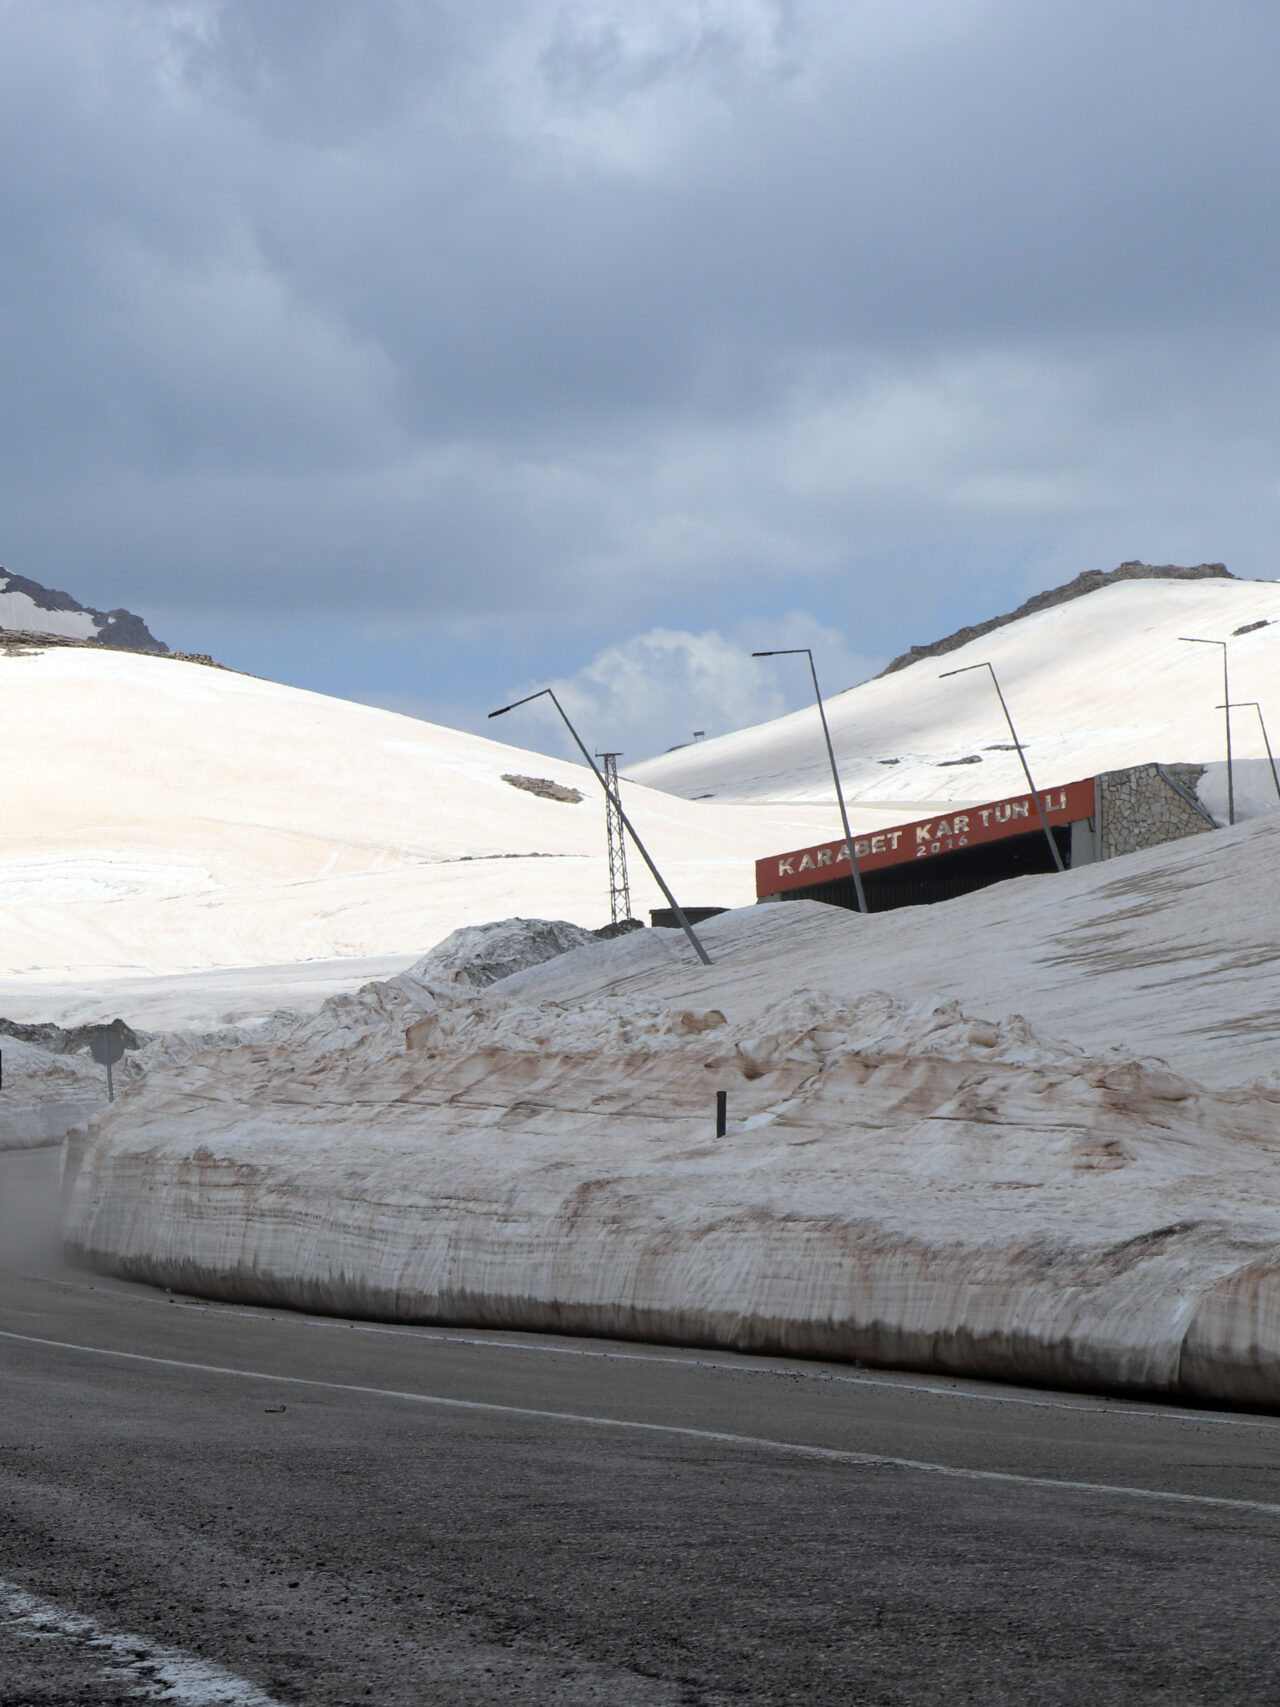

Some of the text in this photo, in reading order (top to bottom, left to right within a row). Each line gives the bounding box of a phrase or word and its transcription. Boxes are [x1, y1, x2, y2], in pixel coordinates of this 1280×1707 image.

[778, 831, 903, 877] KARABET
[916, 815, 970, 843] KAR
[916, 835, 968, 857] 2016
